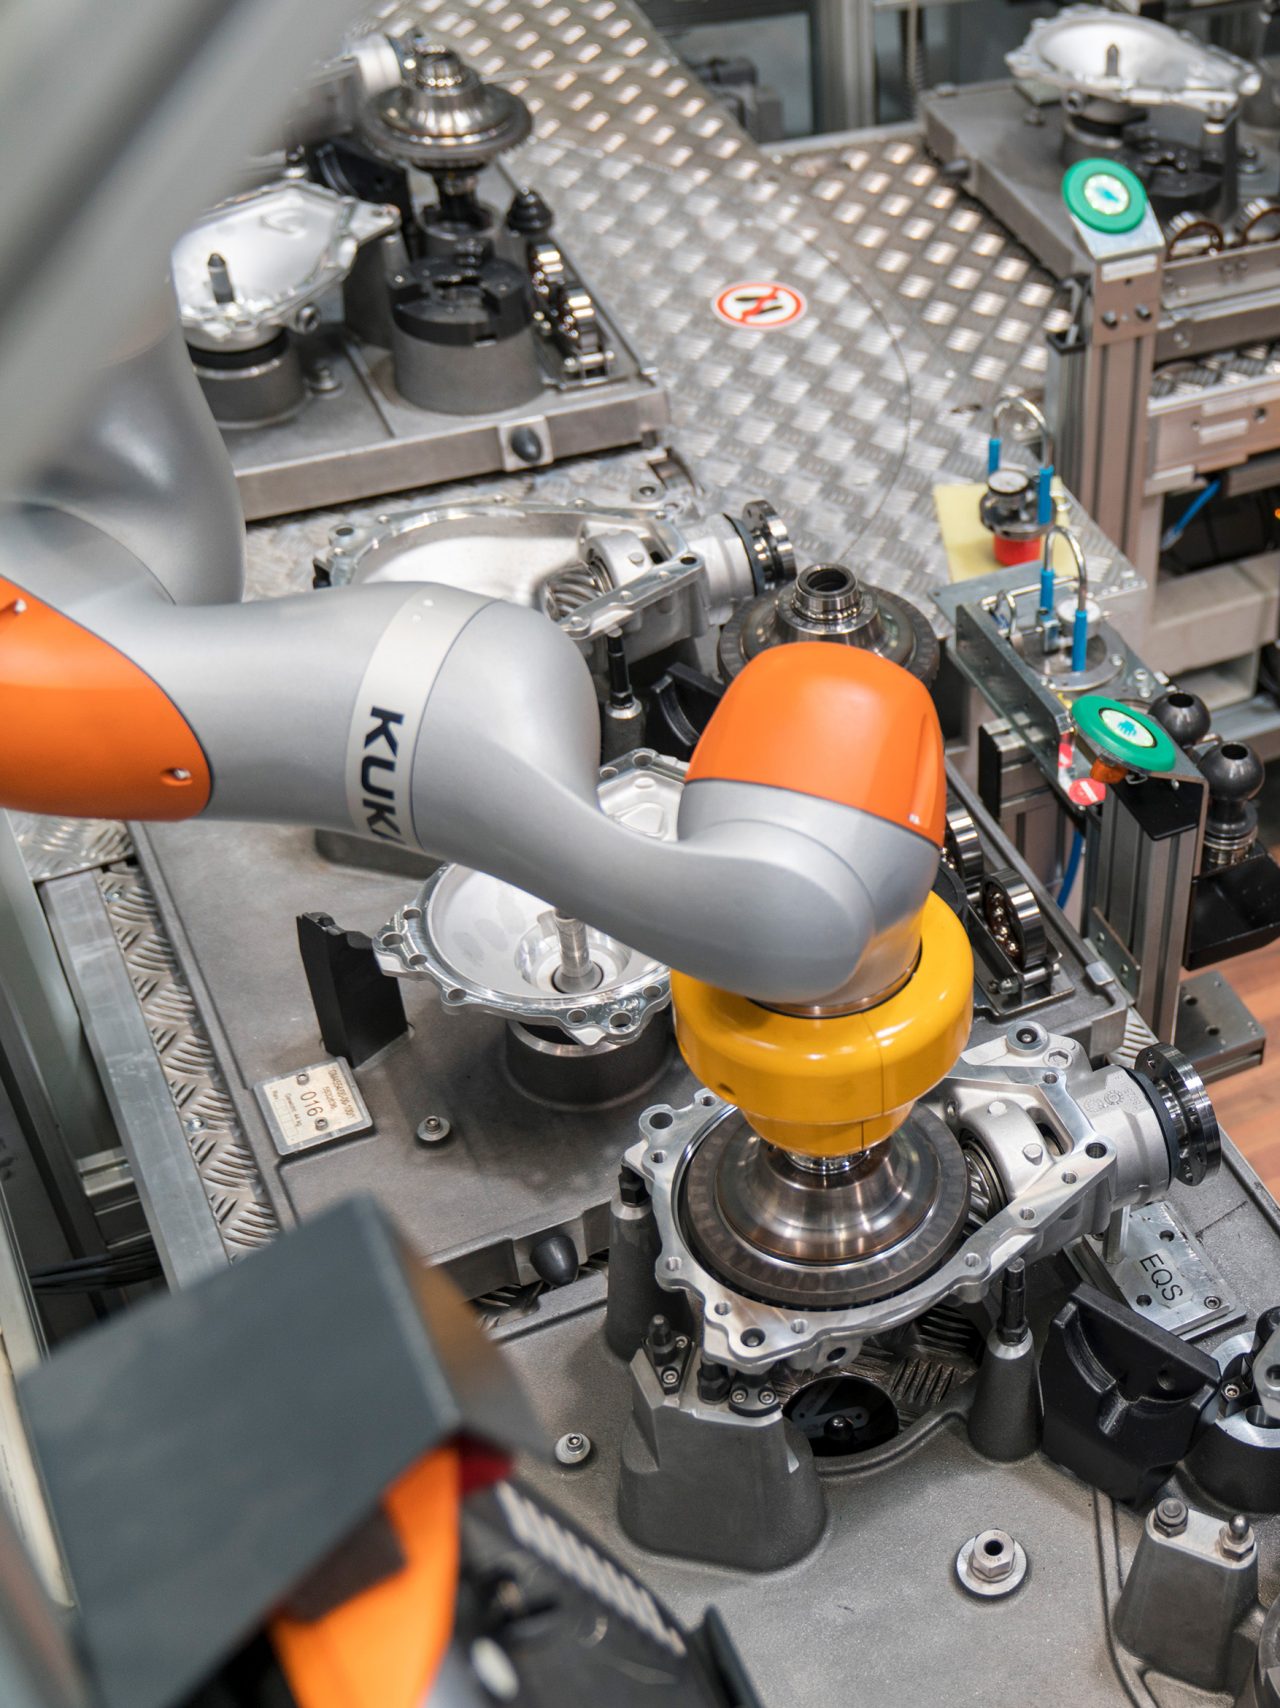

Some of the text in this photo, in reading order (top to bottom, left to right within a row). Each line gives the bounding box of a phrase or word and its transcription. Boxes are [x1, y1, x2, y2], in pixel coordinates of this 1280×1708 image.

[361, 706, 406, 845] KUK
[300, 1091, 324, 1117] 016
[1140, 1253, 1183, 1301] EQS
